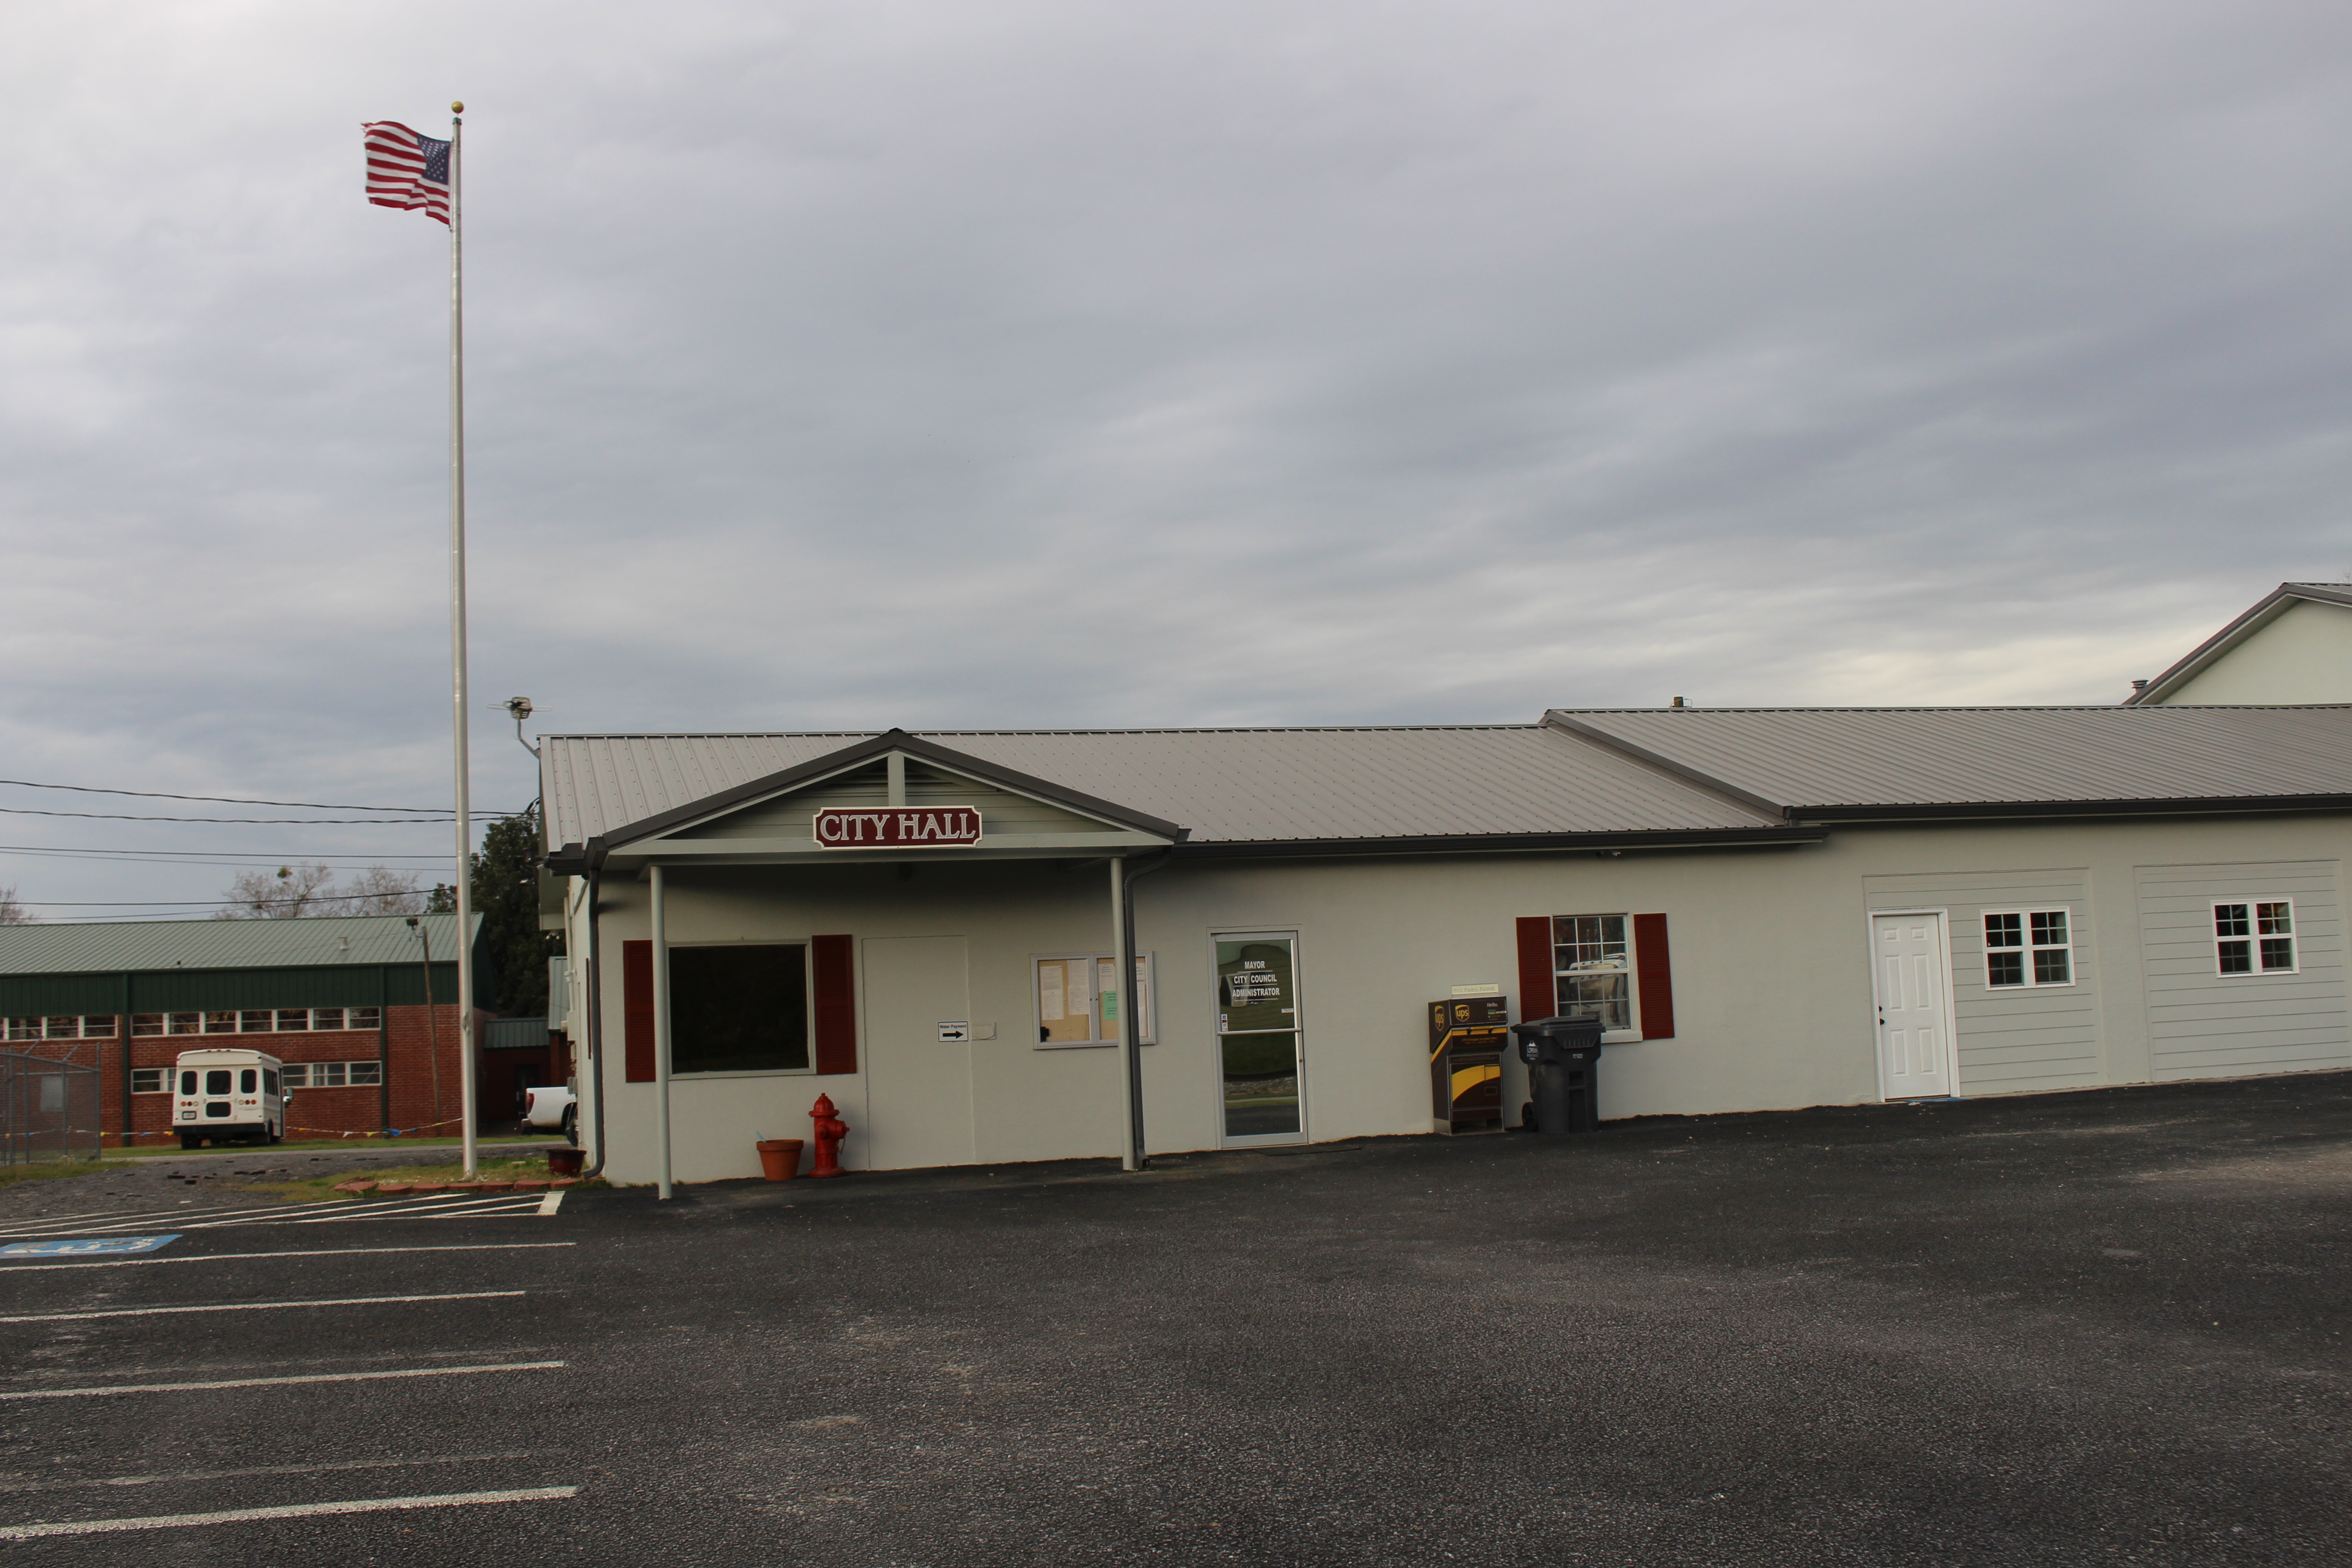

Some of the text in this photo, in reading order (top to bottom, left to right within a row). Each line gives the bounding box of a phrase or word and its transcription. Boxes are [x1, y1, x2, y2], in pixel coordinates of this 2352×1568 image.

[820, 813, 976, 840] CITY HALL
[1234, 975, 1277, 984] CITY COUNCIL
[1232, 988, 1280, 997] ADMINISTRATOR
[1457, 1010, 1468, 1019] ups
